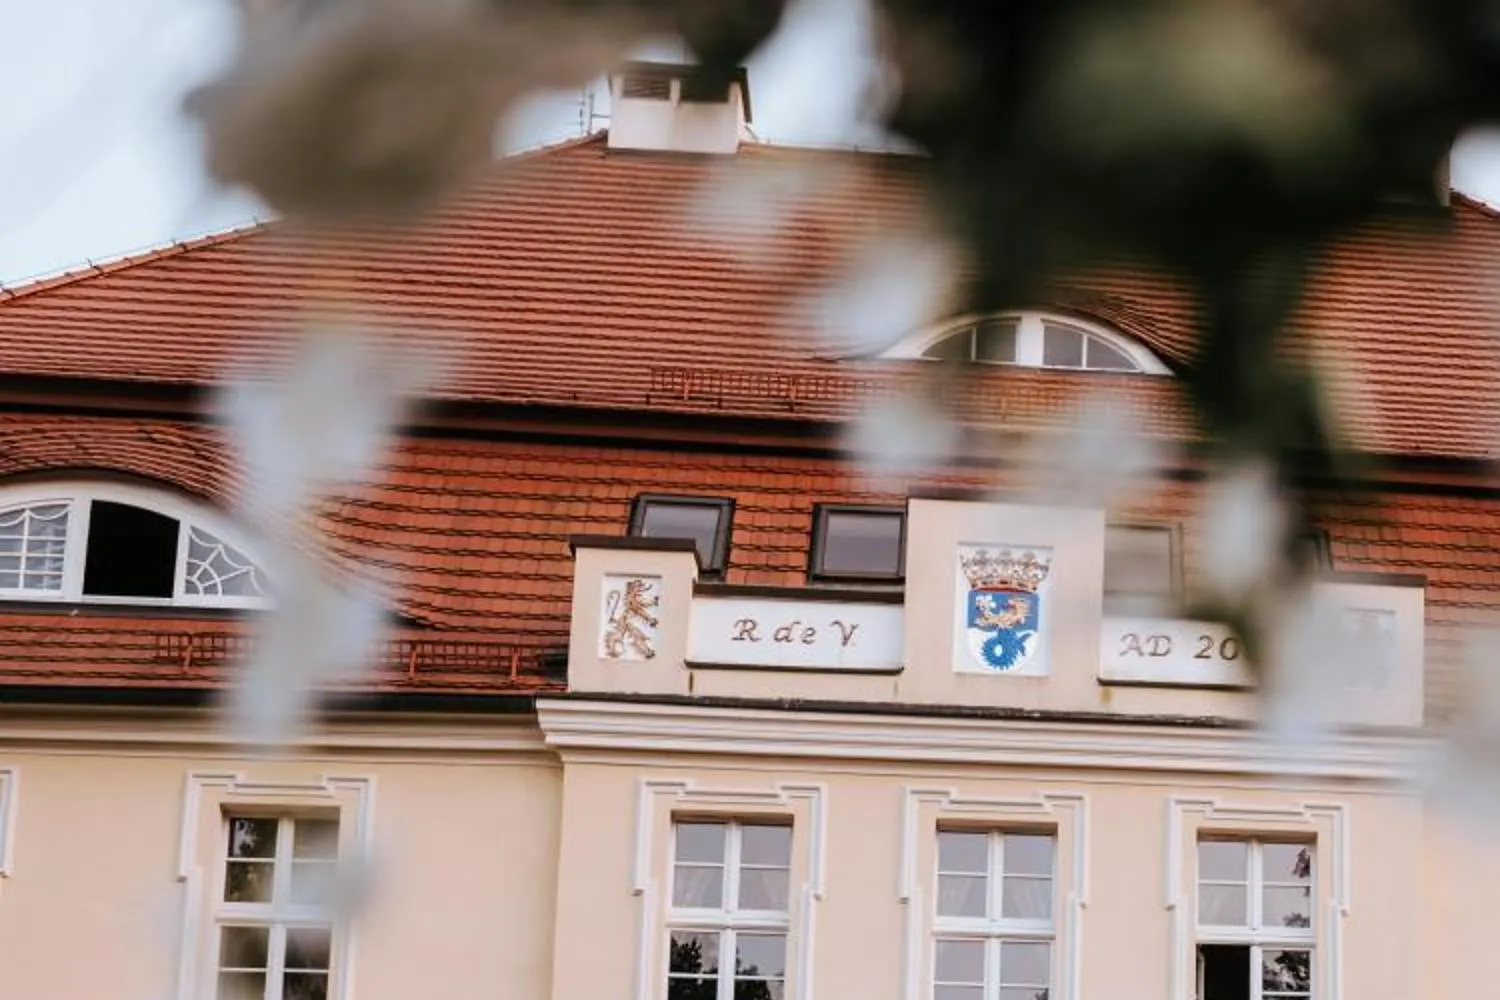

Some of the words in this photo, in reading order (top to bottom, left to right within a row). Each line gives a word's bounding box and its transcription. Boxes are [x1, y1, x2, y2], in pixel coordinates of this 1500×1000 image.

[731, 619, 762, 642] R
[773, 620, 816, 645] de
[1119, 633, 1172, 657] AD
